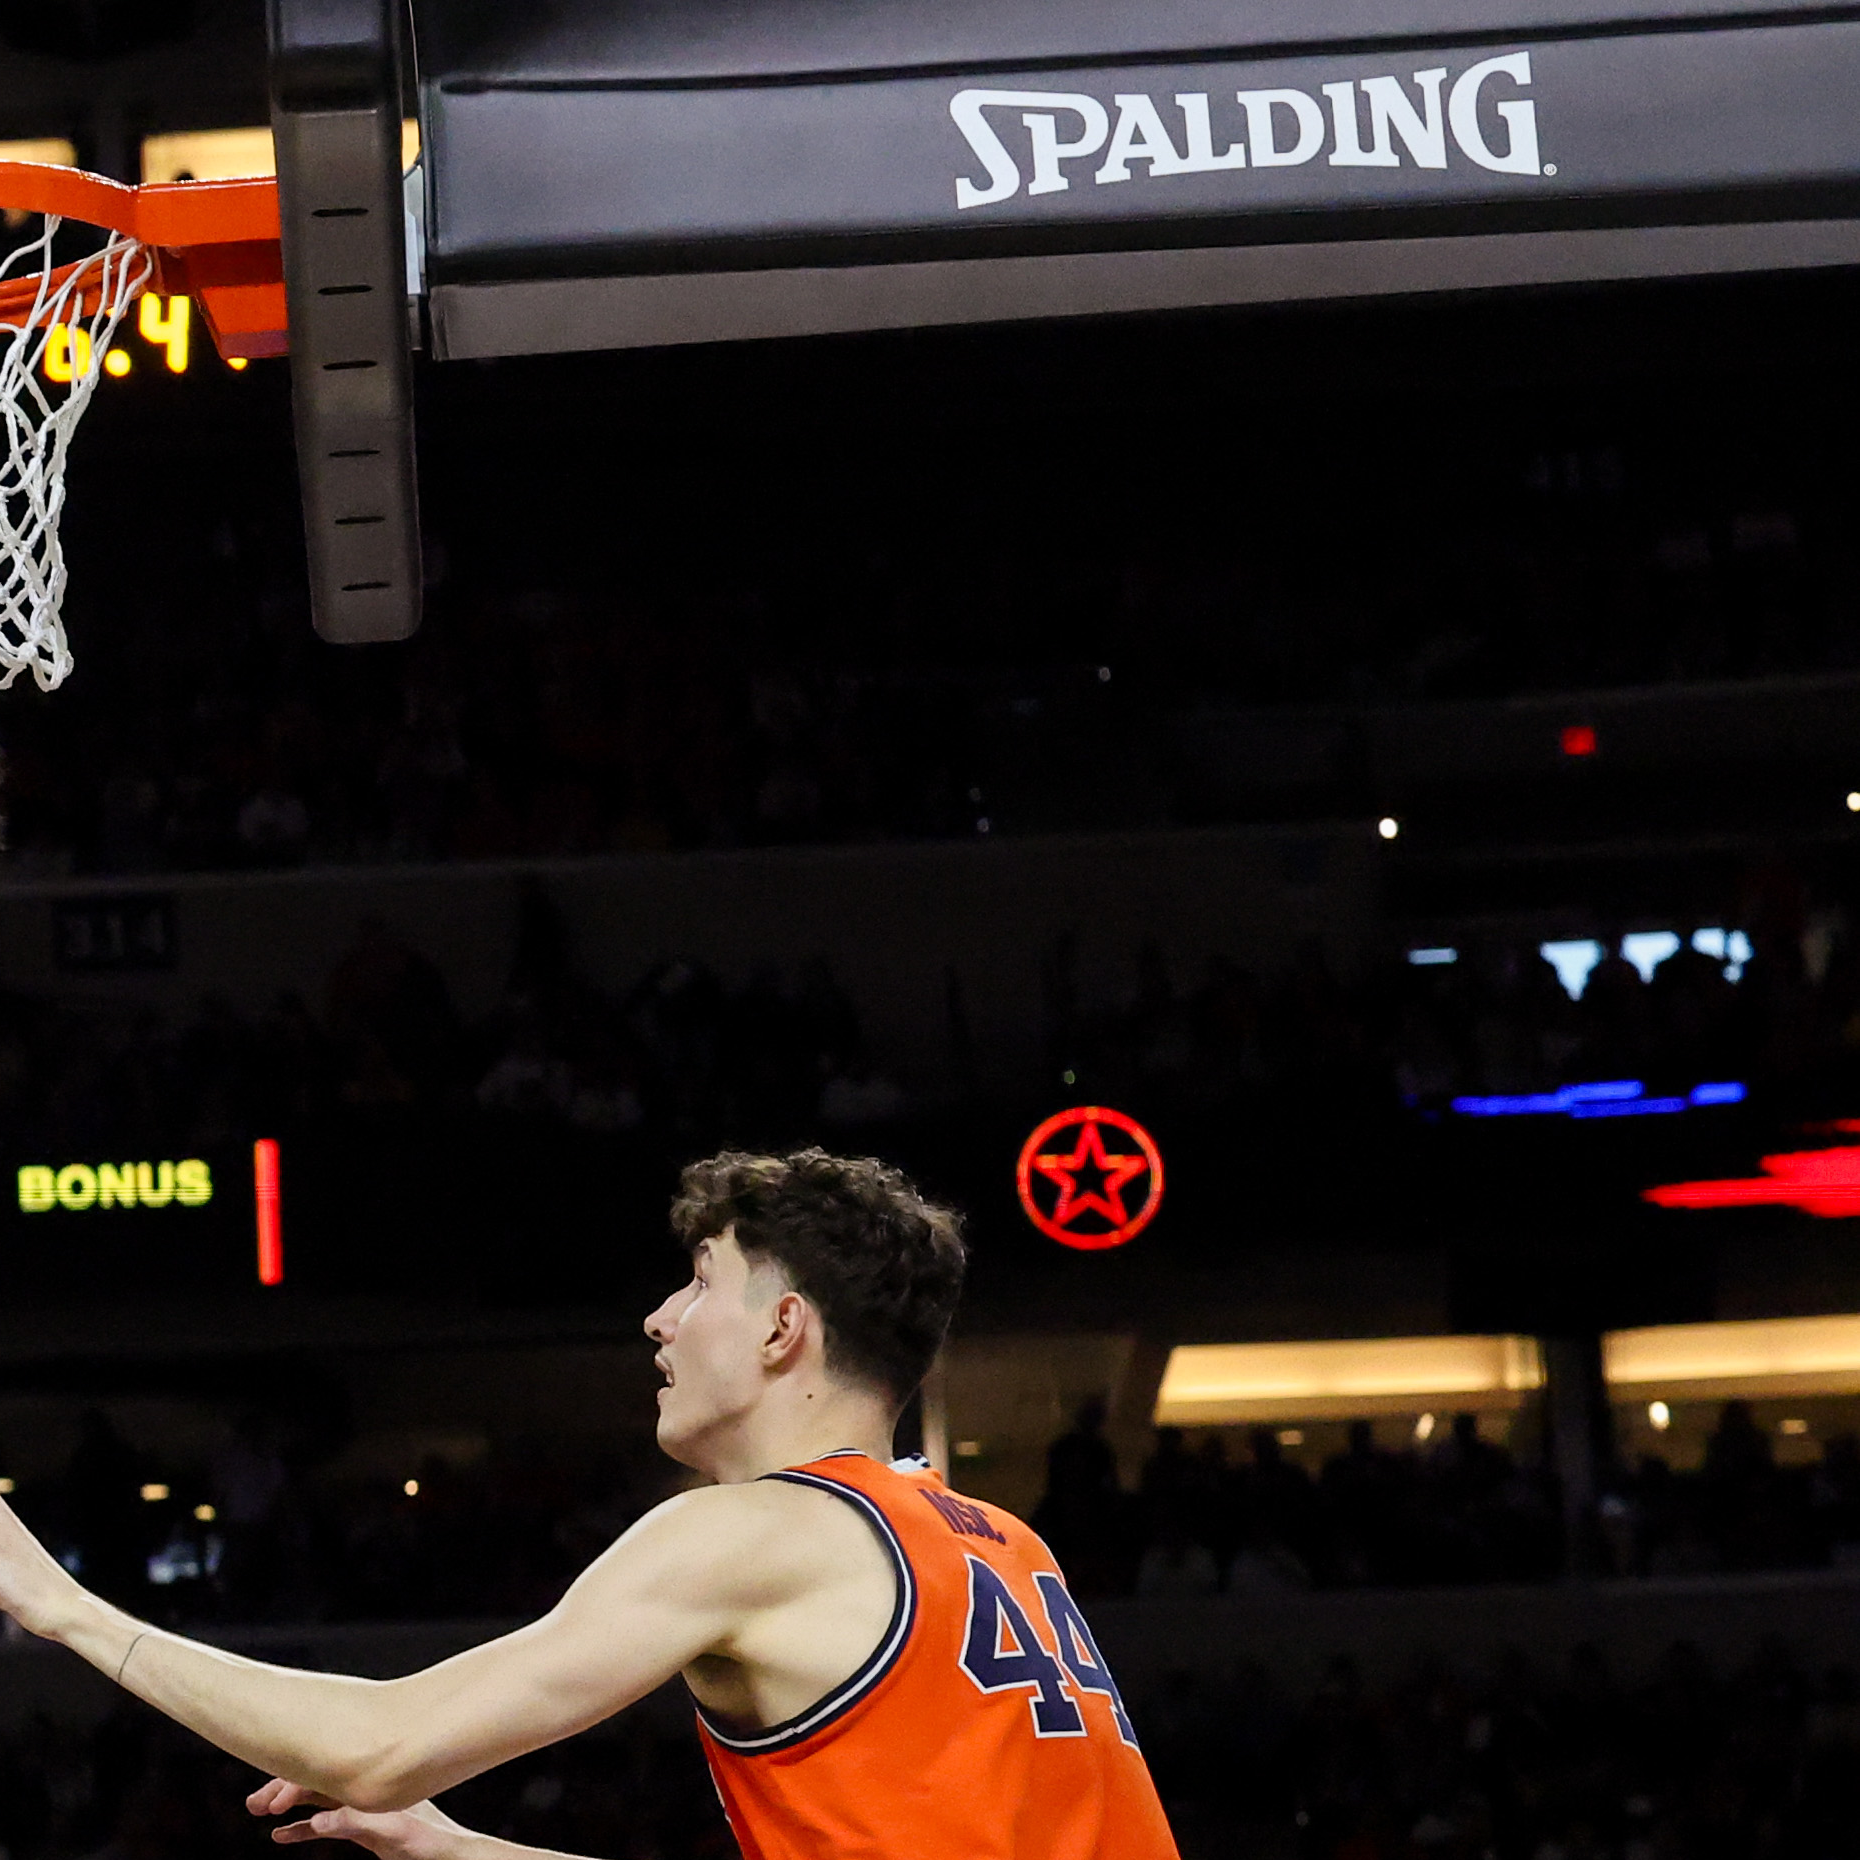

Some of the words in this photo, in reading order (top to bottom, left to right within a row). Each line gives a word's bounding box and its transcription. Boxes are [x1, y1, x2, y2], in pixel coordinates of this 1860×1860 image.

[949, 50, 1541, 210] SPALDING
[17, 1158, 214, 1213] BONUS
[957, 1552, 1142, 1756] 44
